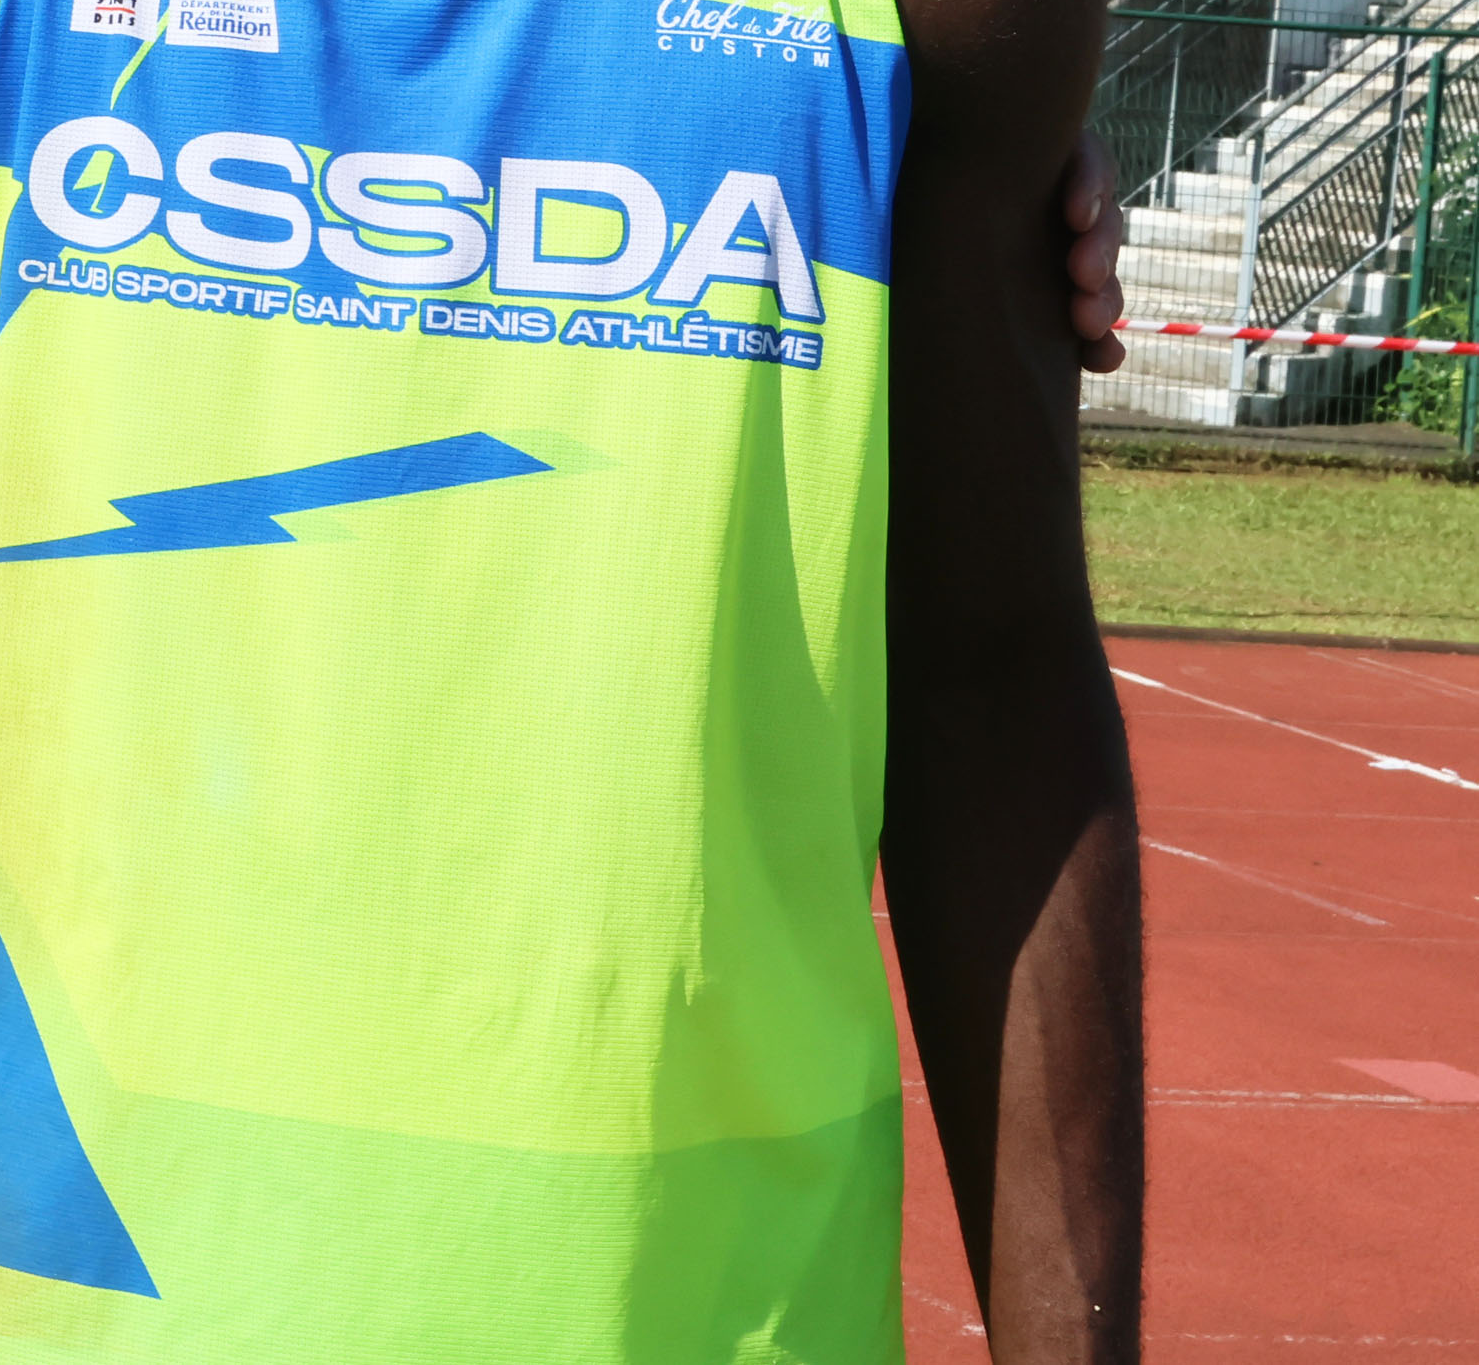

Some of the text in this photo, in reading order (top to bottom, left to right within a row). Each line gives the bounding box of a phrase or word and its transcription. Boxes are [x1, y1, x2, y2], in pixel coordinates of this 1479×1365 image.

[179, 10, 272, 37] Réunion
[181, 0, 270, 14] DÉPARTEMENT
[742, 17, 762, 35] de
[766, 1, 832, 43] File
[657, 35, 830, 67] CUSTOM
[26, 114, 824, 321] CSSDA
[18, 259, 819, 364] CLUB SPORTIF SAINT DENIS ATHLÉTISME
